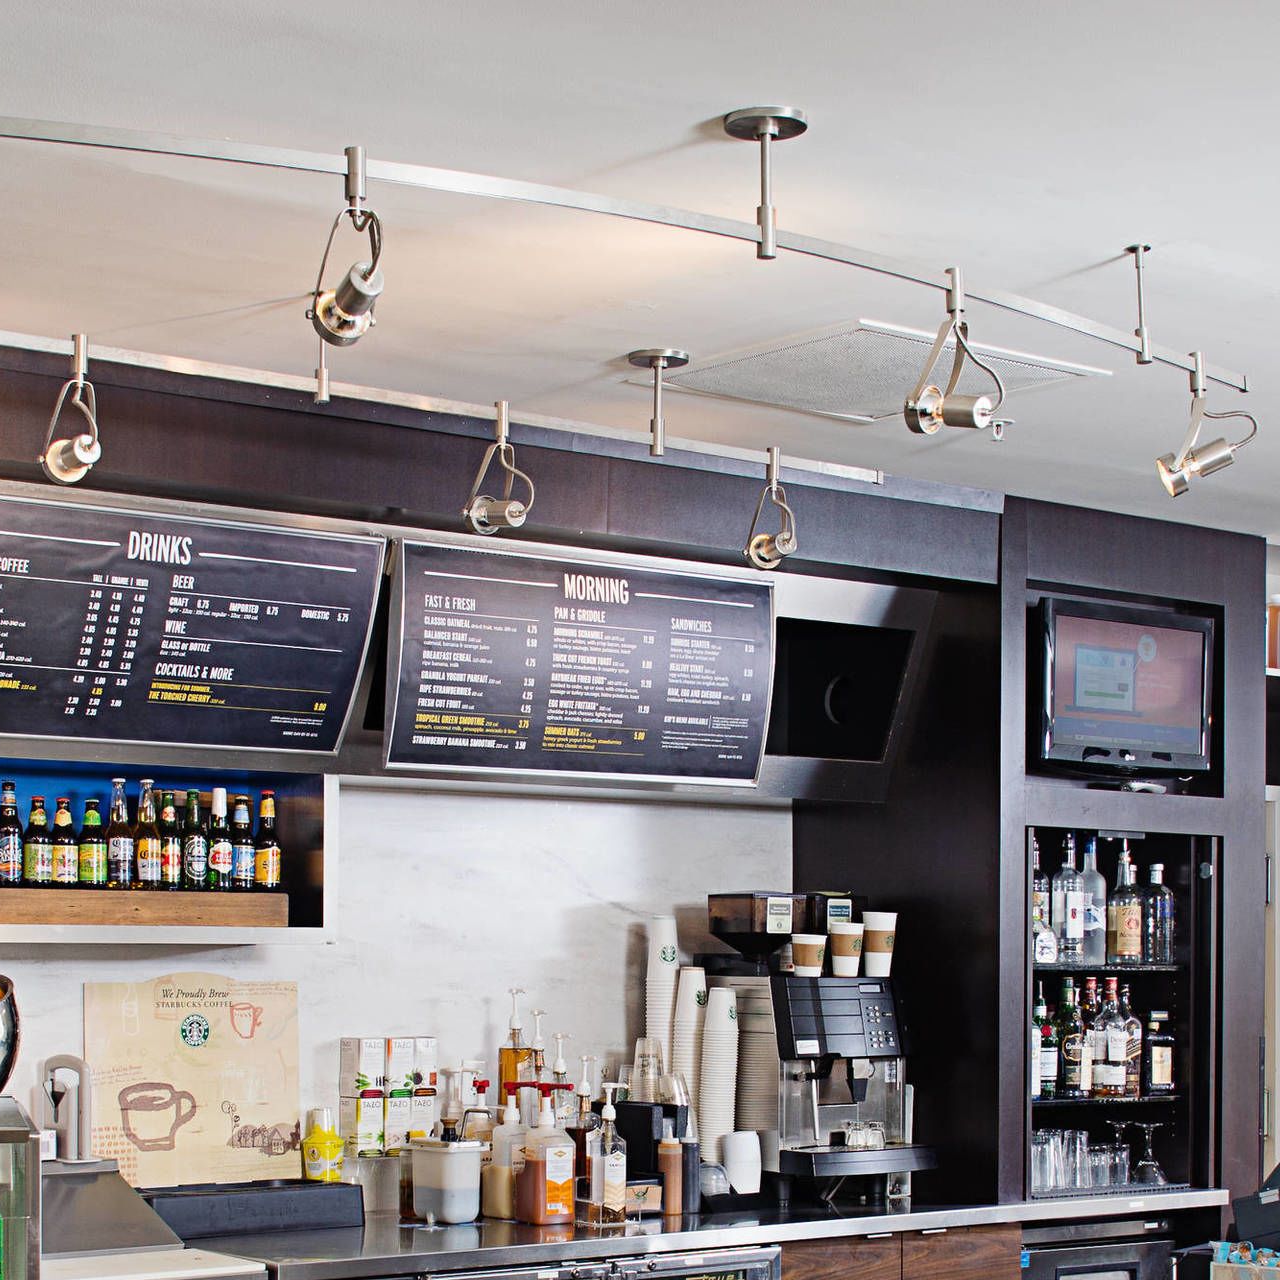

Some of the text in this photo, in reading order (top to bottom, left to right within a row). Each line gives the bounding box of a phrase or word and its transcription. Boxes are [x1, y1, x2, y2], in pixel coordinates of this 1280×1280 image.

[127, 531, 192, 565] DRINKS
[172, 574, 195, 589] BEER
[564, 573, 630, 604] MORNING
[169, 596, 330, 620] CRAFT IMPORTED DOMESTIC
[424, 594, 476, 611] FAST FRESH
[424, 616, 470, 628] CLASSIC OATMEAL
[554, 606, 606, 623] PAN GRIDDLE
[164, 620, 187, 634] WINE
[671, 618, 712, 633] SANDWICHES
[161, 640, 211, 653] GLASS BOTTLE
[155, 662, 234, 681] COCKTAILS MORE
[432, 685, 472, 696] STRAWBERRIES
[412, 736, 447, 746] STRAWBERRY
[162, 989, 173, 999] We
[176, 989, 207, 1000] Proudly
[209, 989, 231, 998] Brew
[155, 1000, 233, 1009] STARBUCKS COFFEE
